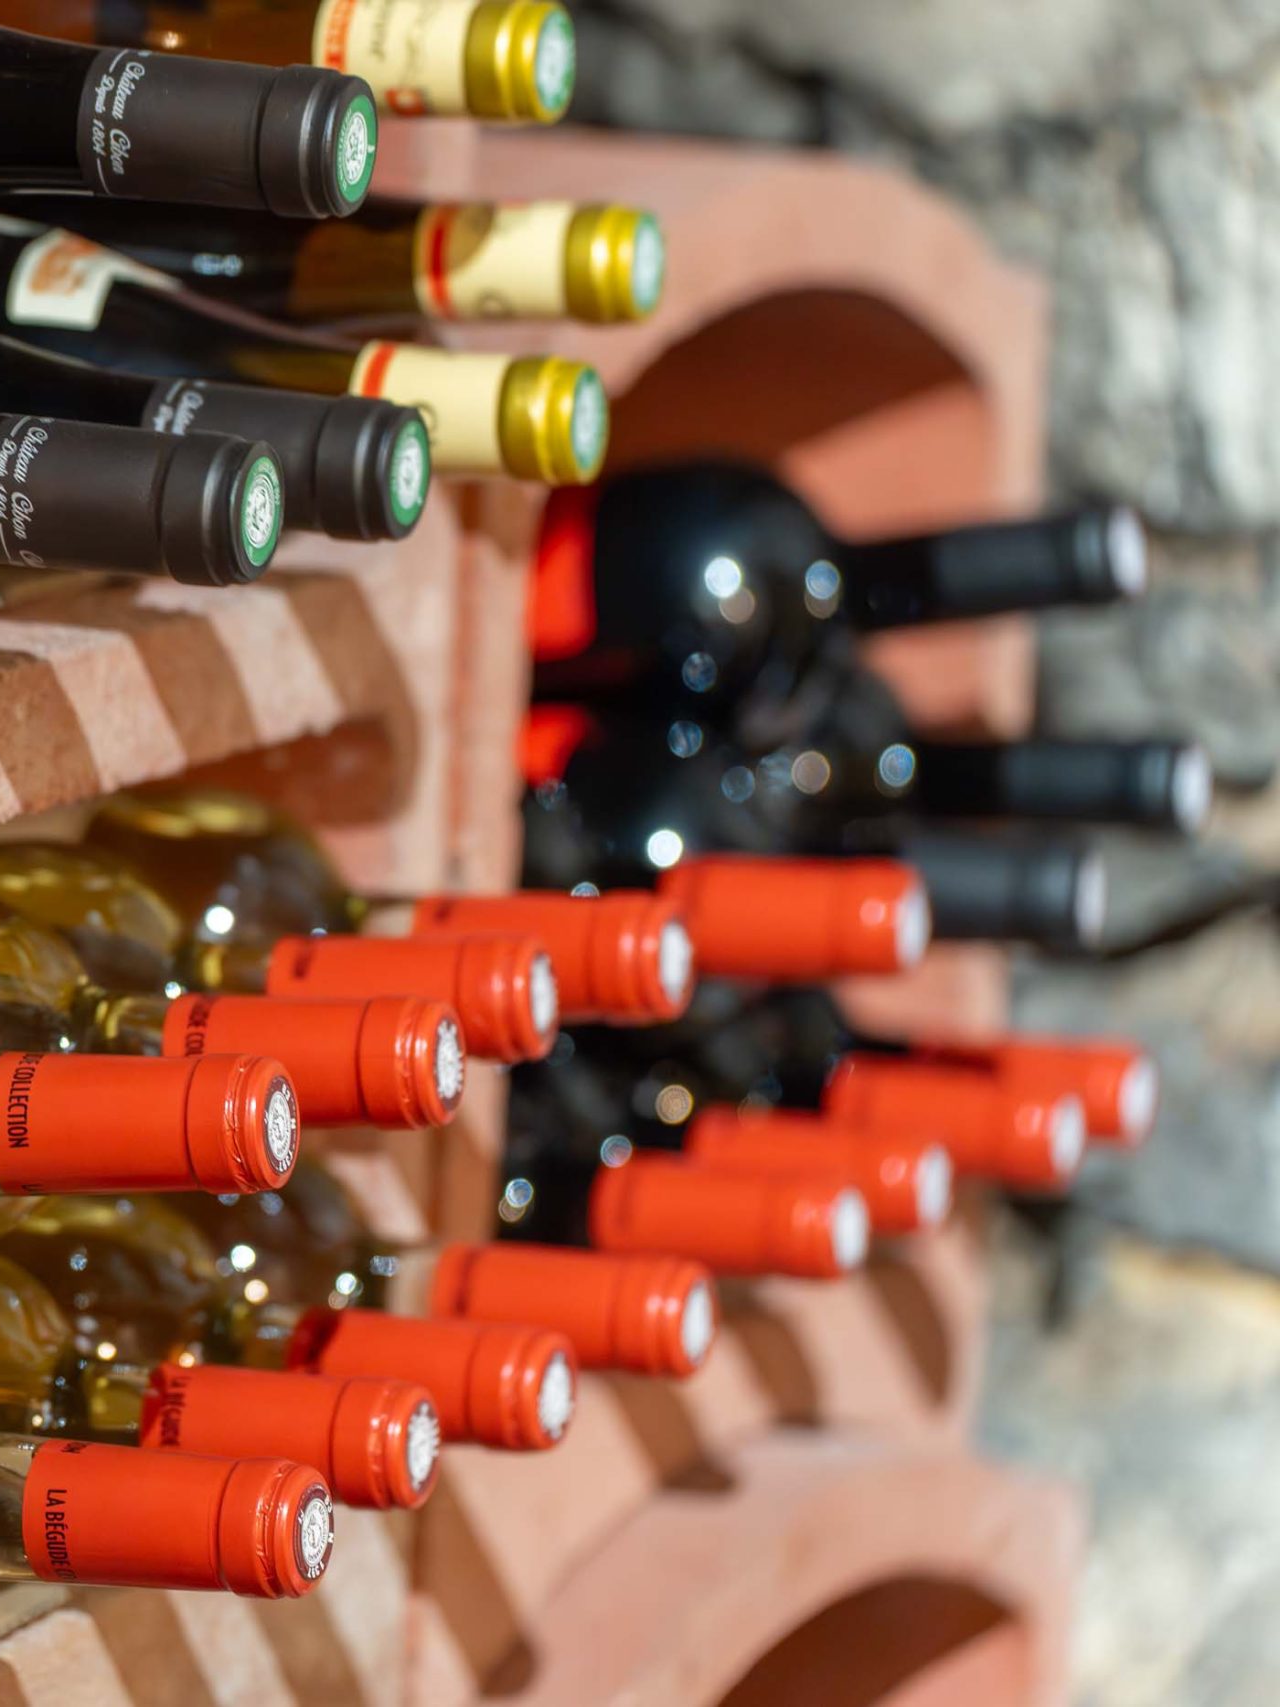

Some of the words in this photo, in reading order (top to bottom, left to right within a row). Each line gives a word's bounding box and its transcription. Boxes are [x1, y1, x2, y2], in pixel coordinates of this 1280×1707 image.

[93, 74, 116, 114] Depuis
[111, 61, 146, 120] Château
[91, 117, 107, 157] 1804
[11, 425, 49, 484] Château
[7, 1066, 36, 1149] COLLECTION
[46, 1489, 67, 1507] LA
[45, 1511, 71, 1566] BÉGUDE
